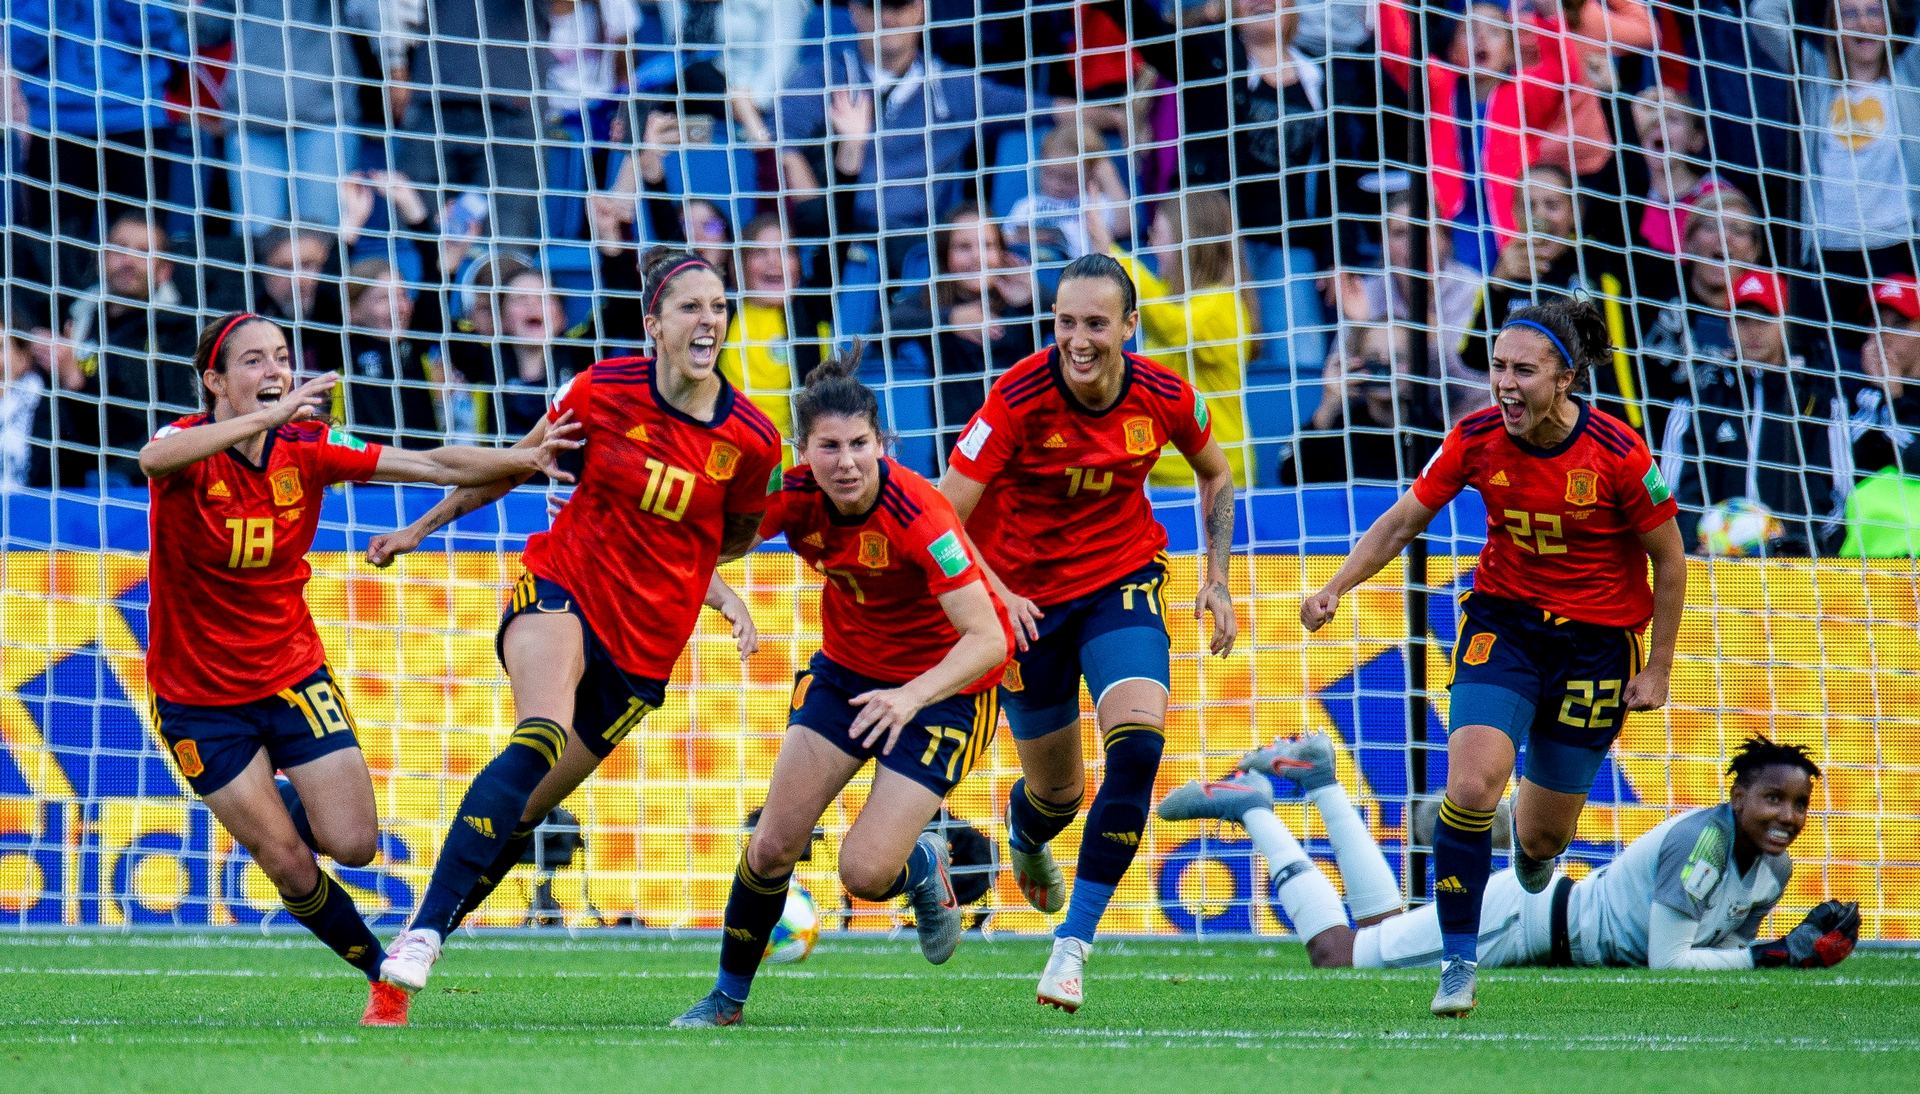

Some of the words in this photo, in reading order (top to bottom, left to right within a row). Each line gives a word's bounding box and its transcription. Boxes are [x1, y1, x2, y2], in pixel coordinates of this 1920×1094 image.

[639, 457, 696, 522] 10
[1065, 467, 1114, 497] 14
[225, 517, 275, 568] 18
[1504, 509, 1568, 555] 22
[287, 681, 349, 739] 18
[1557, 679, 1622, 728] 22
[920, 725, 967, 782] 17
